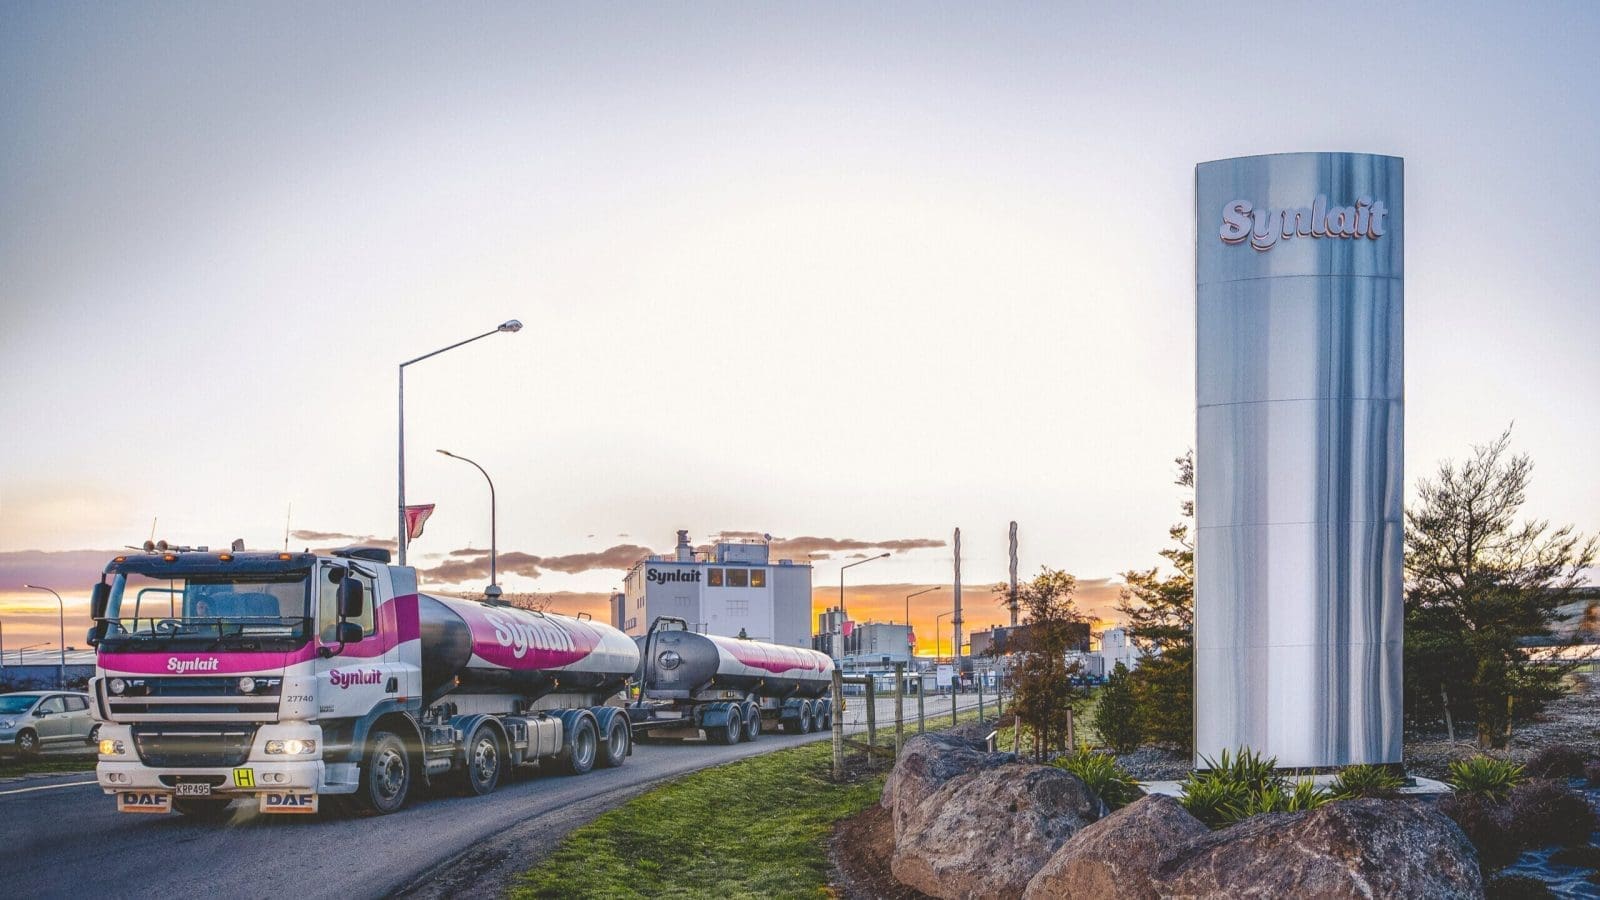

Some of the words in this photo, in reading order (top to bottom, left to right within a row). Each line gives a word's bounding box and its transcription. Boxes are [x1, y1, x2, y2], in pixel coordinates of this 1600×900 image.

[1220, 194, 1389, 251] Synlait
[647, 568, 702, 585] Synlait
[484, 610, 577, 659] Synlait
[167, 657, 219, 673] Synlait
[329, 669, 382, 689] Synlait
[287, 695, 314, 703] 27740
[237, 770, 251, 785] H
[176, 785, 210, 795] KRP495
[123, 793, 168, 805] DAF
[266, 793, 313, 805] DAF
